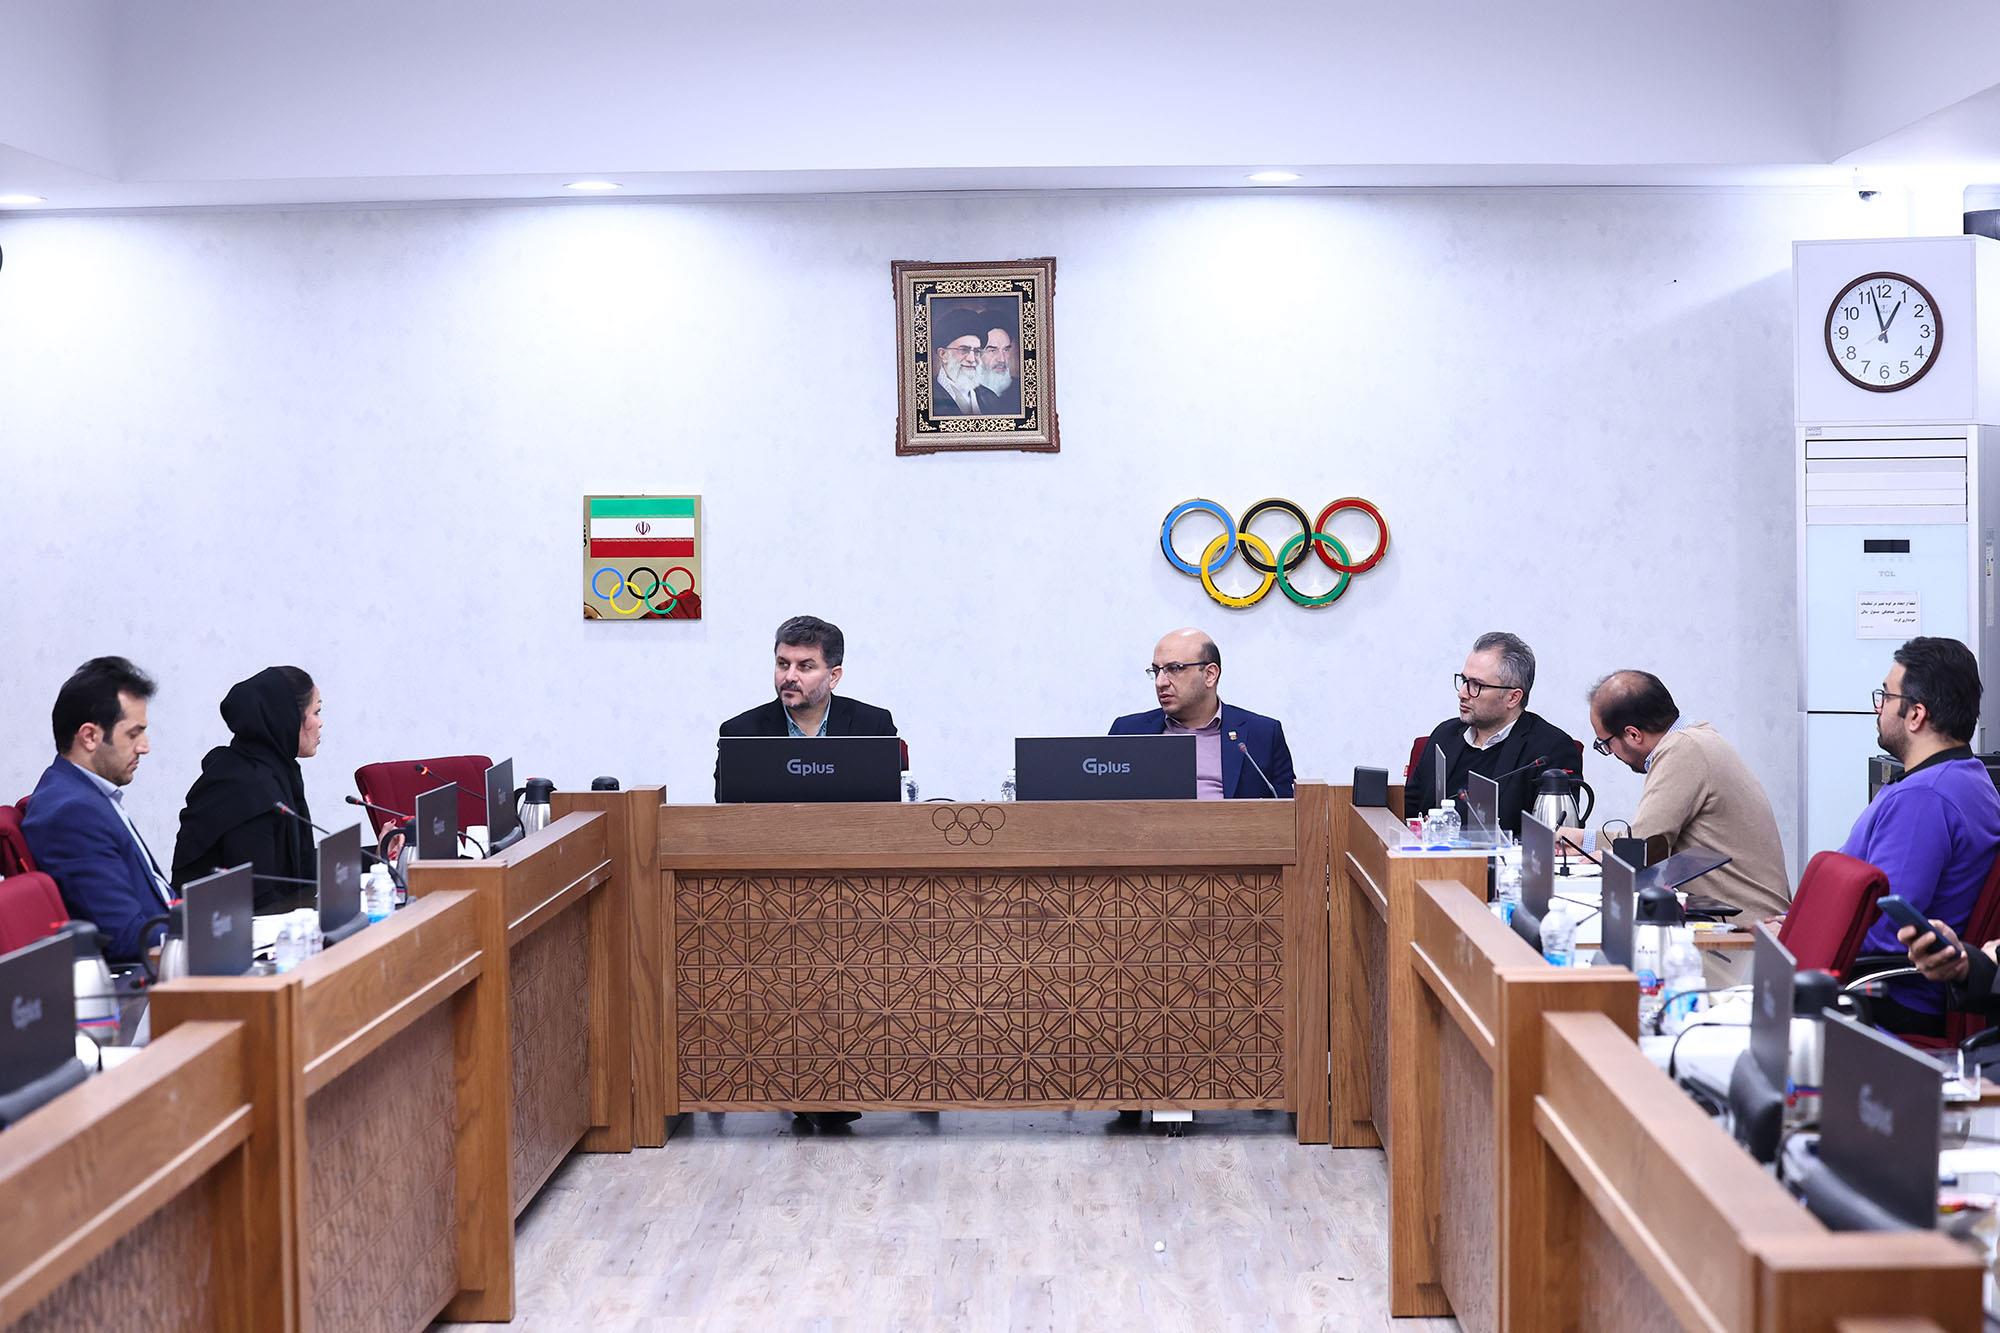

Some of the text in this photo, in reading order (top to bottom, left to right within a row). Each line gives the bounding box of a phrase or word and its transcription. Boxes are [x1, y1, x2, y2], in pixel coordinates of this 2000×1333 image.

[1859, 291, 1871, 304] 11
[1876, 284, 1892, 298] 12
[1901, 290, 1907, 303] 1
[1844, 306, 1860, 320] 10
[1914, 304, 1924, 318] 2
[1838, 325, 1849, 340] 9
[1920, 324, 1931, 338] 3
[1846, 345, 1857, 360] 8
[1914, 345, 1924, 358] 4
[1861, 360, 1871, 374] 7
[1879, 365, 1890, 379] 6
[1899, 360, 1910, 374] 5
[786, 758, 835, 776] Gplus
[1082, 757, 1131, 776] Gplus
